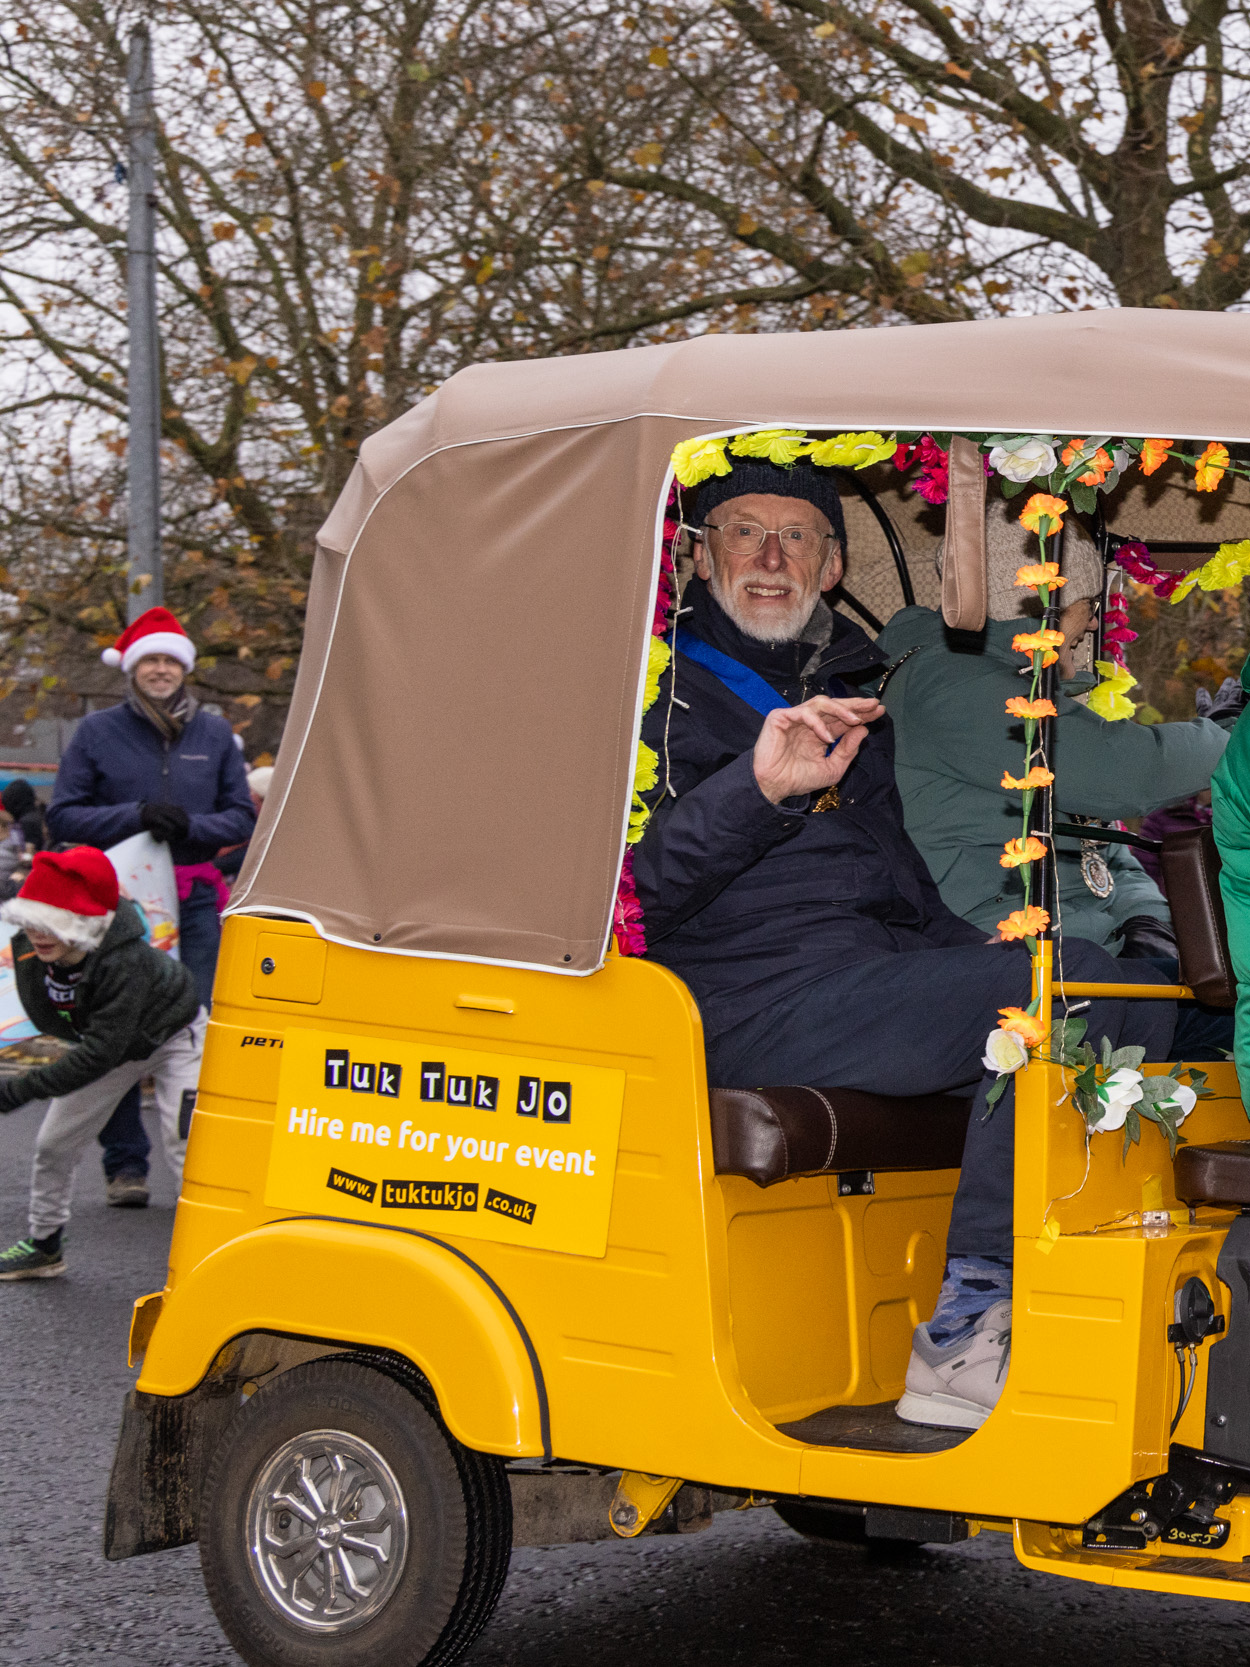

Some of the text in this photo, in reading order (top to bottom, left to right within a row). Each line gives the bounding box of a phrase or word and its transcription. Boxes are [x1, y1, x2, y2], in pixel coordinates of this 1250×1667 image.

[326, 1058, 397, 1095] Tuk
[422, 1071, 494, 1108] Tuk
[288, 1106, 597, 1177] Hire me for your event
[332, 1173, 534, 1221] www. tuktukjo .co.uk
